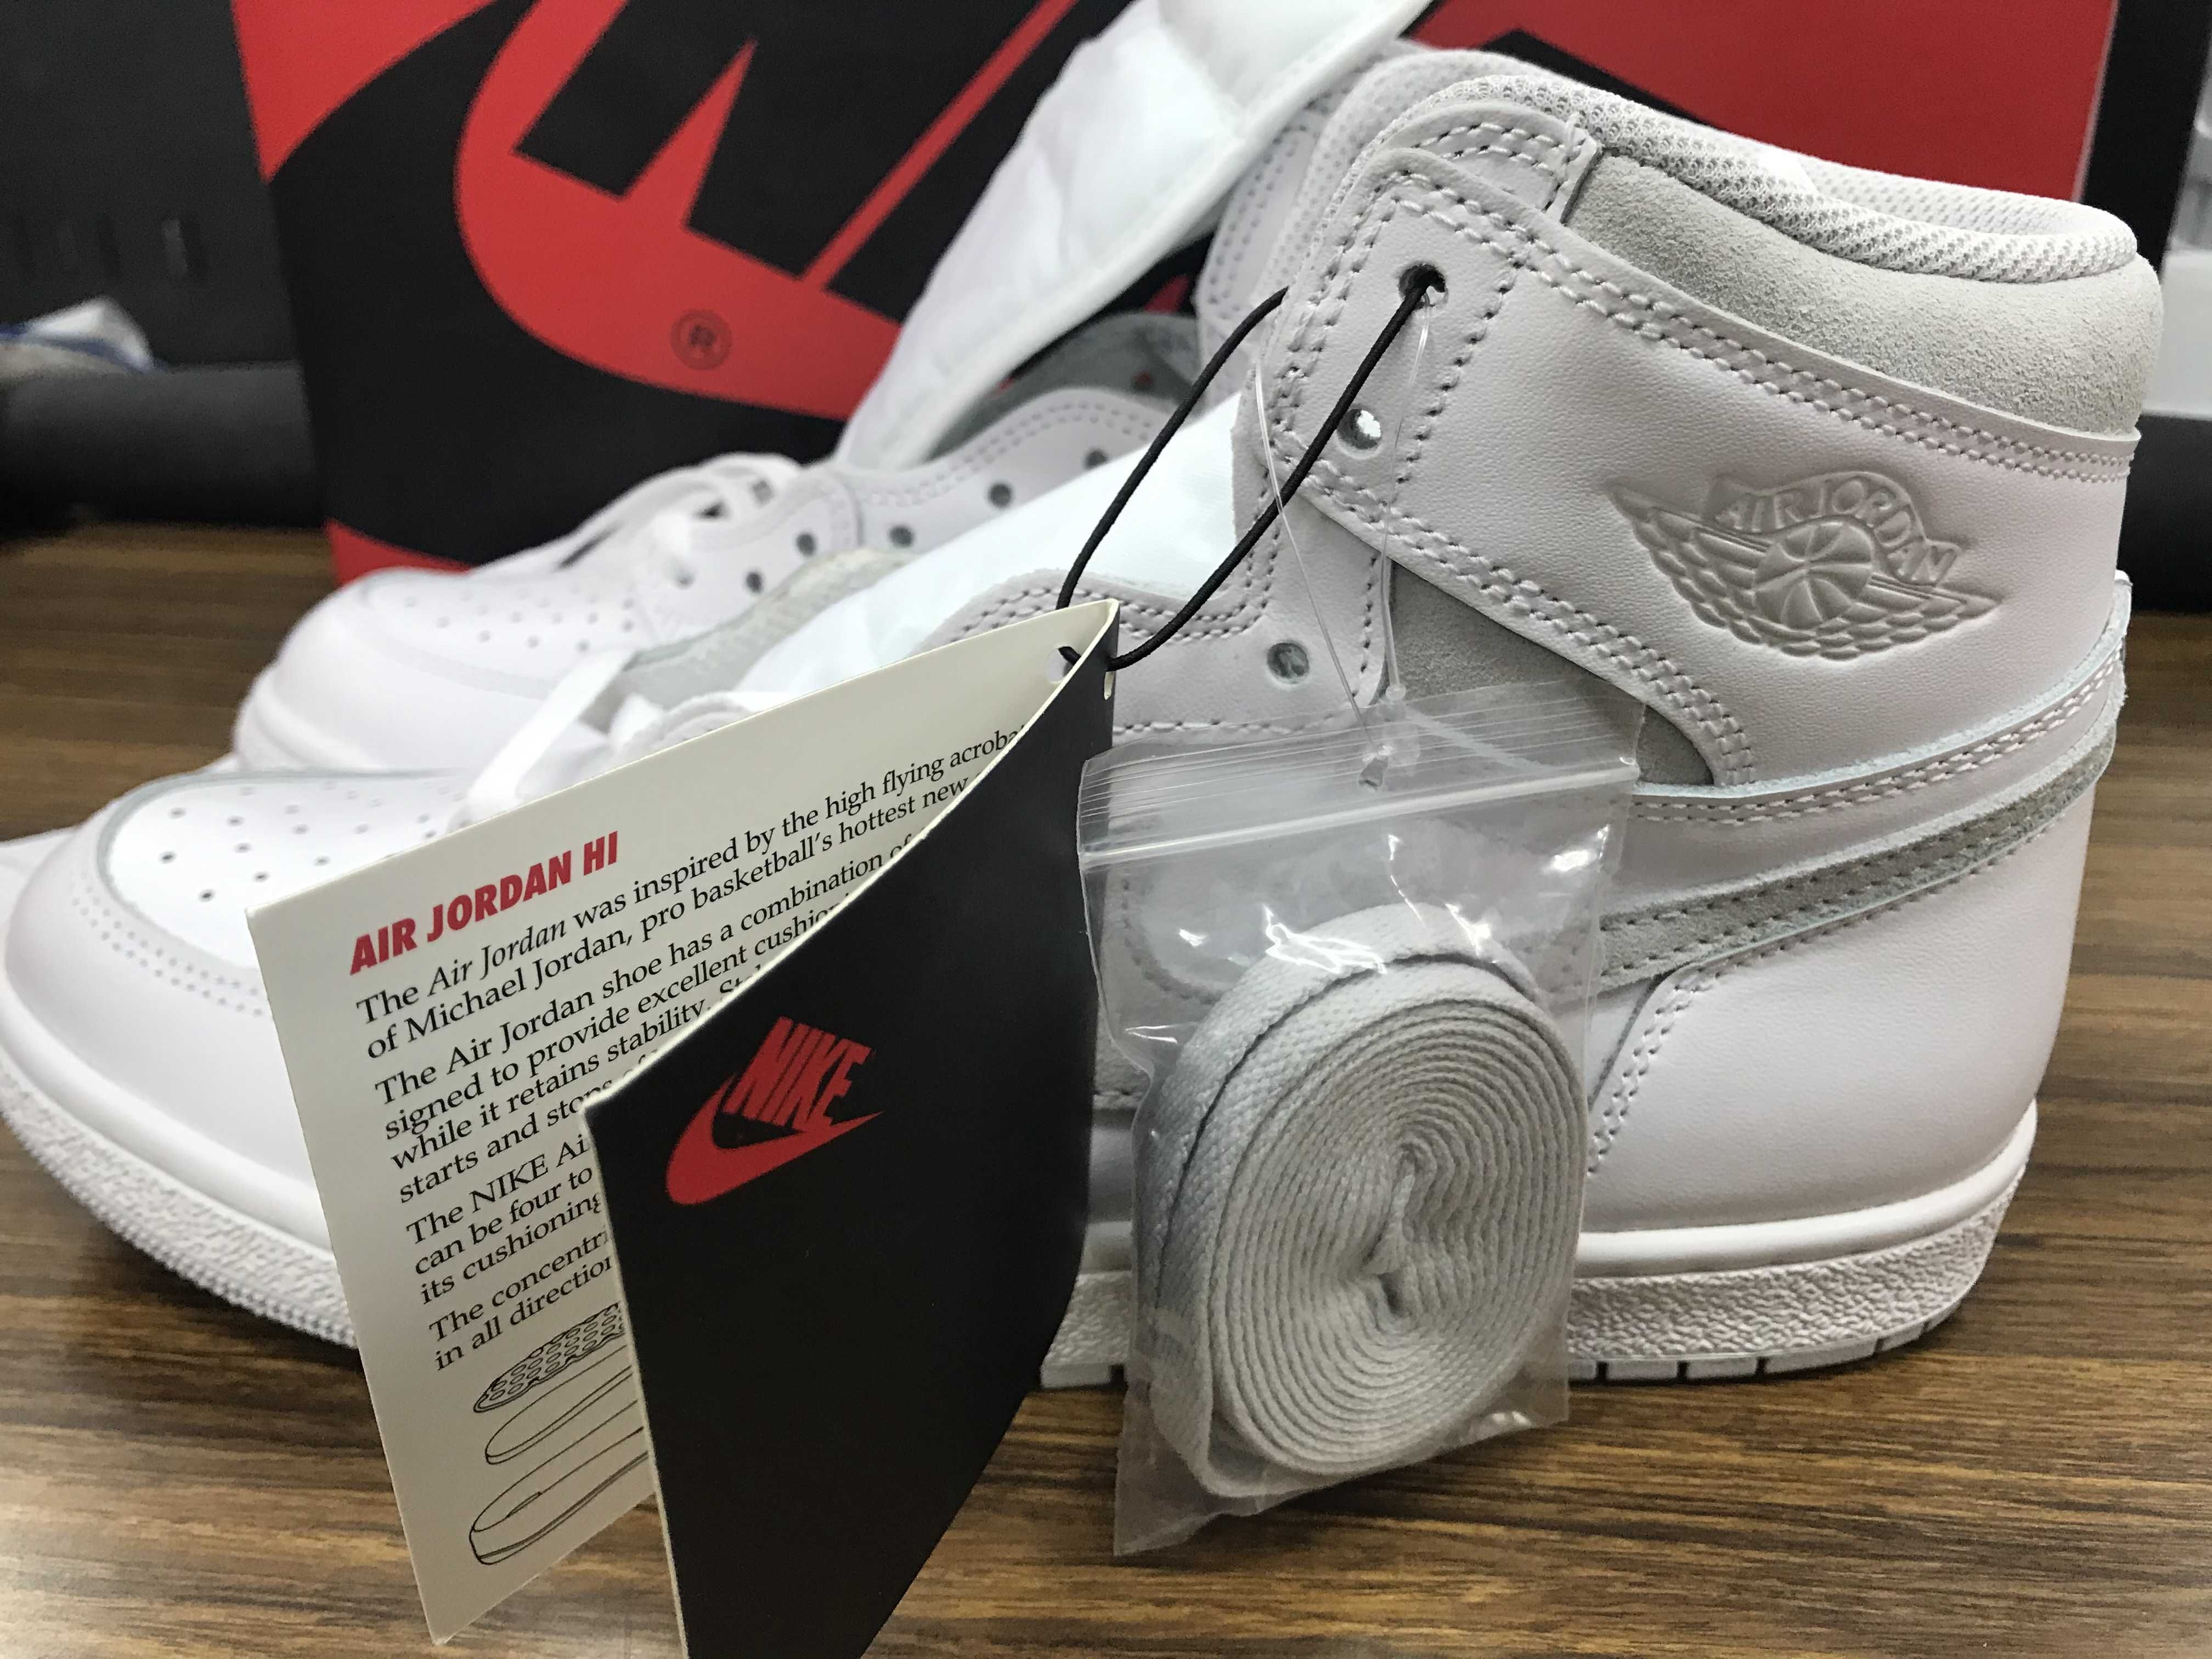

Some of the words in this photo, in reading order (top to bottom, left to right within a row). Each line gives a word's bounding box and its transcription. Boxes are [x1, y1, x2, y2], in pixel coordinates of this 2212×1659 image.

[350, 917, 417, 975] AIR
[427, 850, 571, 943] JORDAN
[584, 831, 618, 876] HI
[356, 986, 419, 1024] The
[427, 959, 472, 996] Air
[480, 919, 566, 980] Jordan
[573, 894, 626, 929] was
[634, 837, 739, 904] inspired
[744, 827, 775, 855] by
[781, 809, 819, 837] the
[825, 782, 876, 819] high
[882, 758, 945, 797] flying
[368, 1024, 399, 1059] of
[404, 967, 527, 1042] Michael
[532, 928, 633, 990] Jordan,
[640, 901, 685, 944] pro
[838, 795, 916, 844] hottest
[922, 777, 968, 808] new
[374, 1066, 437, 1105] The
[446, 1037, 493, 1075] Air
[499, 991, 595, 1054] Jordan
[602, 957, 662, 998] shoe
[668, 933, 713, 968] has
[720, 923, 734, 942] a
[741, 854, 883, 931] combination
[385, 1072, 484, 1140] signed
[490, 1062, 519, 1086] to
[527, 1007, 630, 1077] provide
[638, 945, 748, 1013] excellent
[724, 1017, 871, 1130] NIKE
[391, 1119, 472, 1170] while
[480, 1101, 500, 1128] it
[506, 1053, 600, 1114] retains
[399, 1151, 479, 1204] starts
[487, 1113, 540, 1158] and
[405, 1206, 464, 1244] The
[469, 1154, 548, 1214] NIKE
[415, 1238, 465, 1275] can
[468, 1217, 503, 1245] be
[510, 1183, 562, 1224] four
[568, 1168, 592, 1190] to
[420, 1276, 455, 1305] its
[428, 1303, 484, 1342] The
[435, 1345, 465, 1370] in
[472, 1316, 503, 1350] all
